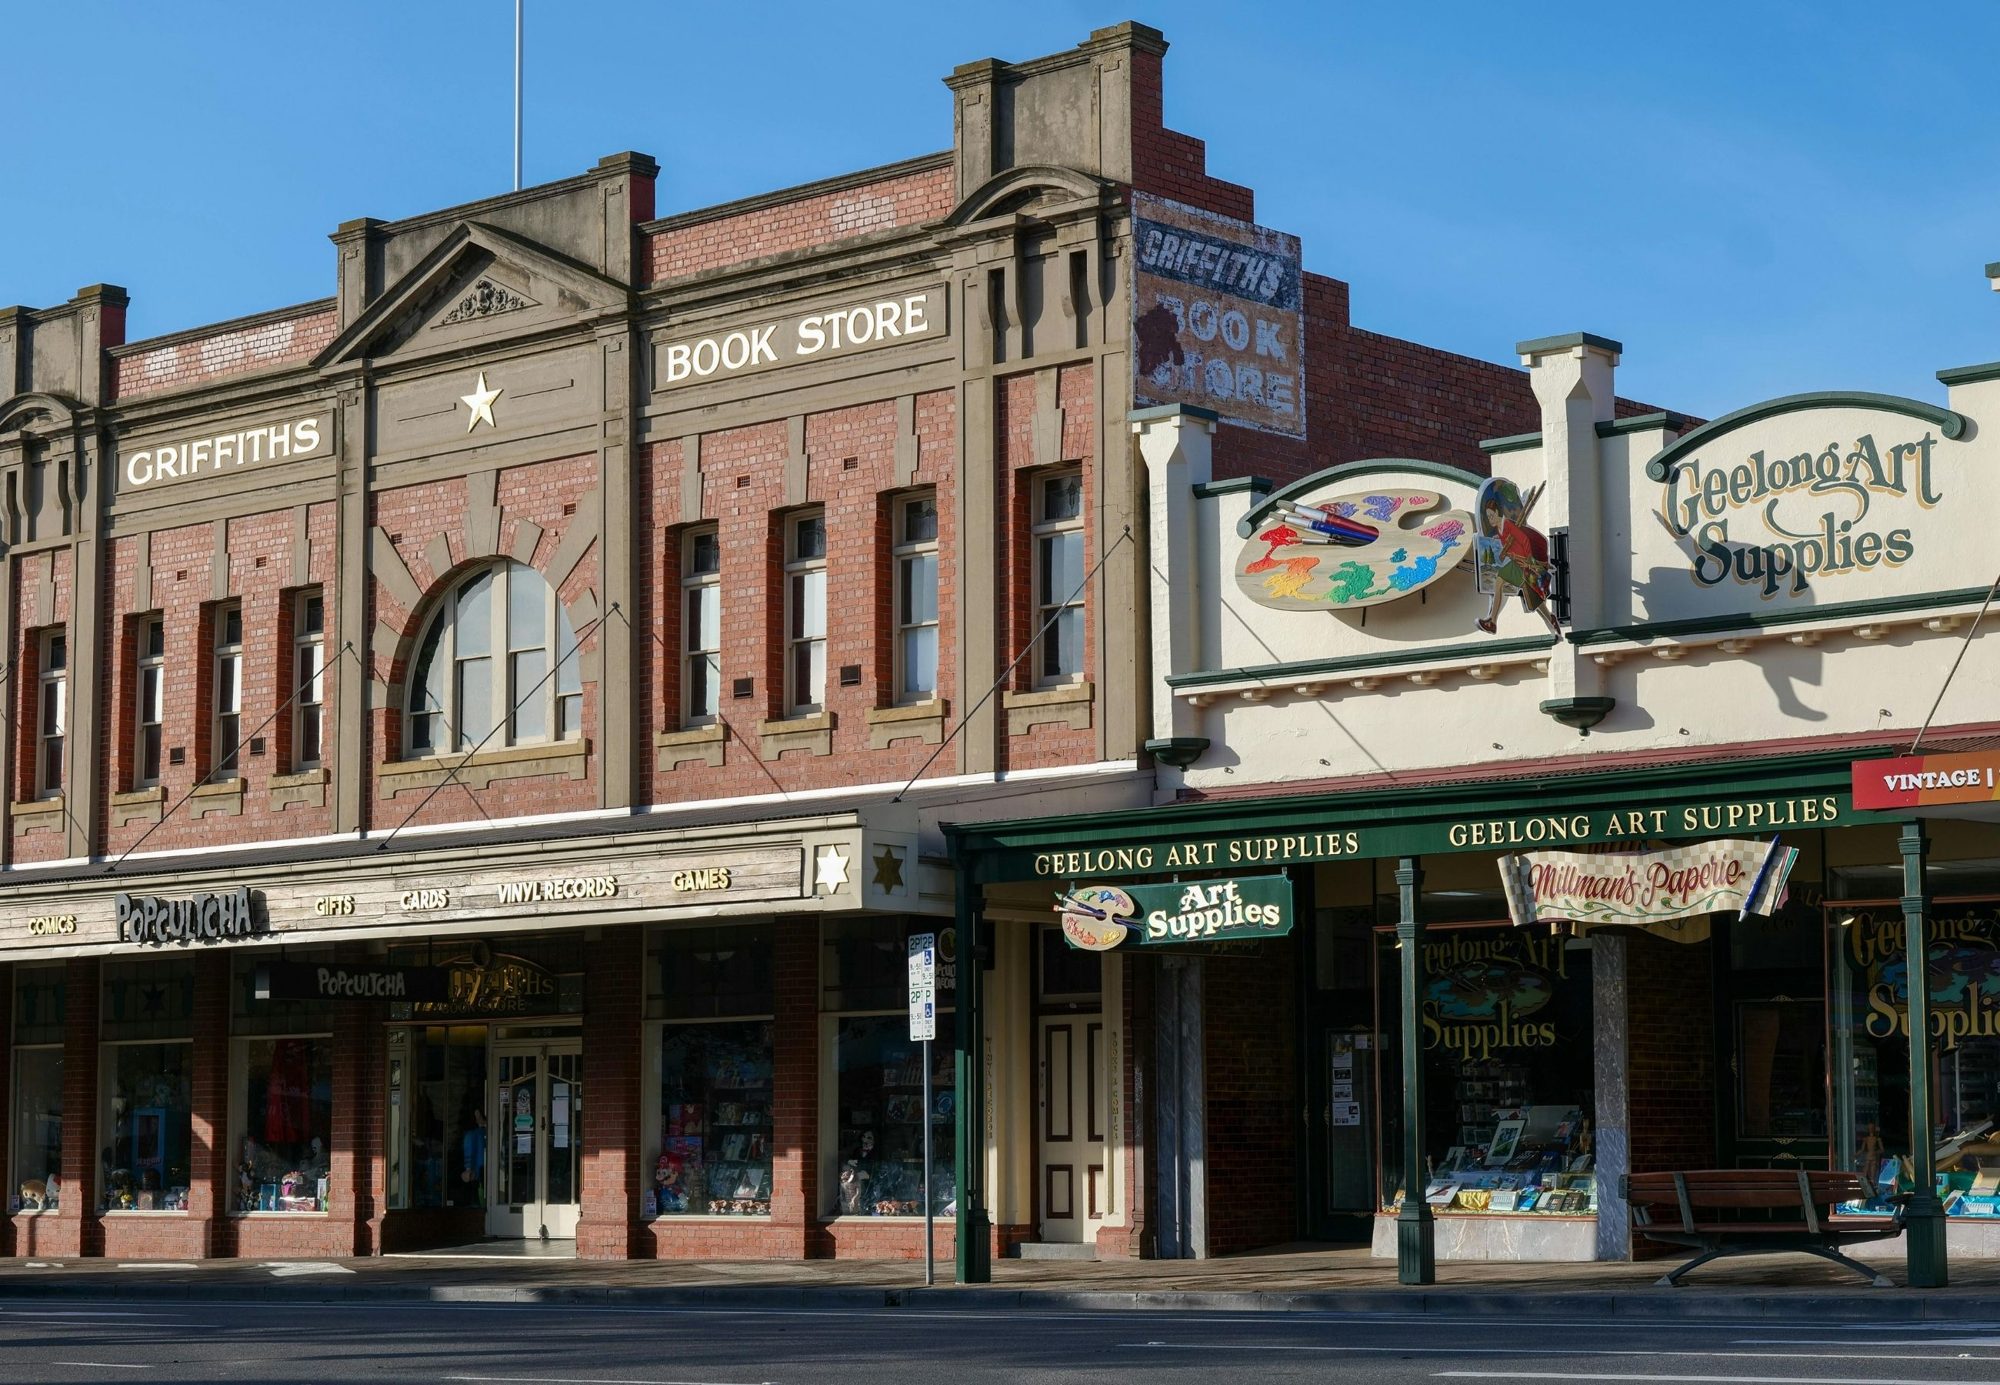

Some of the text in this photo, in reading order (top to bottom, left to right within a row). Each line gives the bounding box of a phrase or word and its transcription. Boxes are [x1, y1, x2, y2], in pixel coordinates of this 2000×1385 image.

[1142, 229, 1285, 300] GRIFFITHS
[666, 294, 929, 383] BOOK STORE
[127, 418, 321, 486] GRIFFITHS
[1665, 431, 1943, 536] Geelong Art
[1692, 511, 1915, 597] Supplies
[1883, 768, 1981, 792] VINTAGE
[1449, 797, 1839, 848] GEELONG ART SUPPLIES
[1034, 832, 1360, 876] GEELONG ART SUPPLIES
[400, 888, 451, 910] CARDS
[497, 875, 619, 904] VINYL RECORDS
[671, 867, 731, 892] GAMES
[1180, 880, 1240, 911] Art
[1528, 863, 1641, 906] Millman's
[1641, 853, 1745, 908] Paperie
[28, 915, 77, 935] COMICS
[314, 895, 355, 916] GIFTS
[1148, 898, 1281, 938] Supplies
[922, 935, 933, 950] 2P
[1424, 932, 1505, 976] eelong
[1852, 908, 1976, 967] Geeong
[911, 990, 921, 1004] 2P
[1423, 999, 1557, 1061] Supplies
